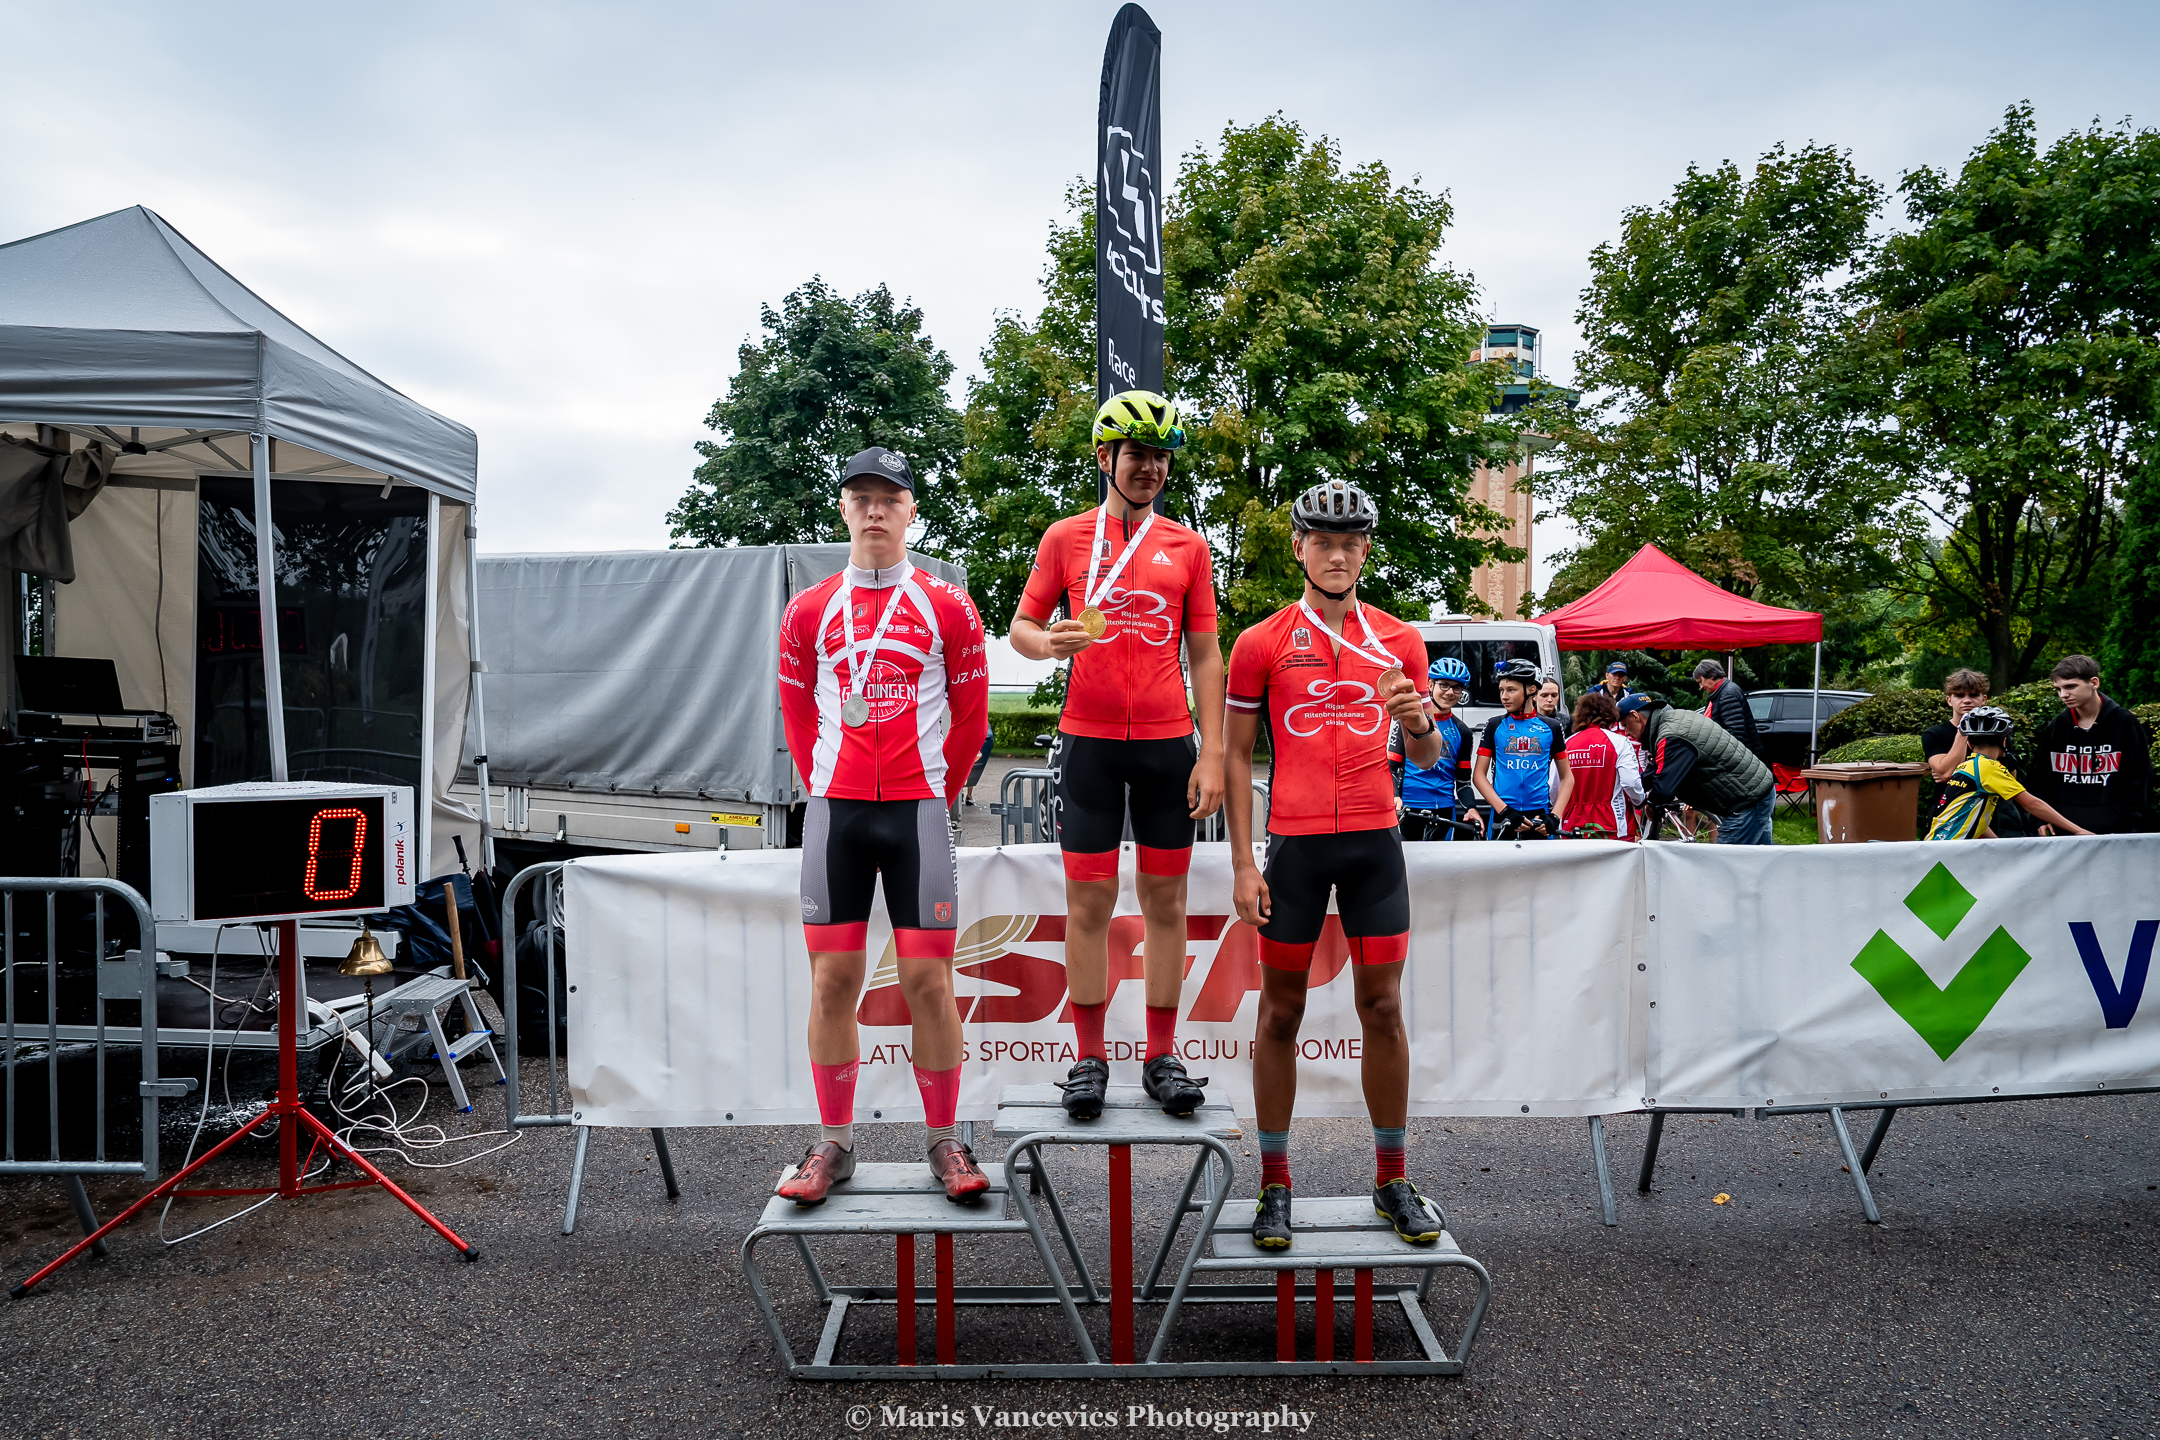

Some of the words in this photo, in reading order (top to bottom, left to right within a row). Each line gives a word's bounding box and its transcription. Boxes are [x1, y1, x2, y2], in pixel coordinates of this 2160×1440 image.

[1108, 337, 1136, 389] Race
[946, 584, 977, 631] Vēvers
[1389, 722, 1401, 747] RRS
[2054, 751, 2122, 774] UNION
[2063, 773, 2111, 787] FAMILY
[304, 808, 368, 900] 0
[394, 838, 407, 886] polanik
[2067, 919, 2160, 1030] V
[979, 1040, 1078, 1063] SPORTA
